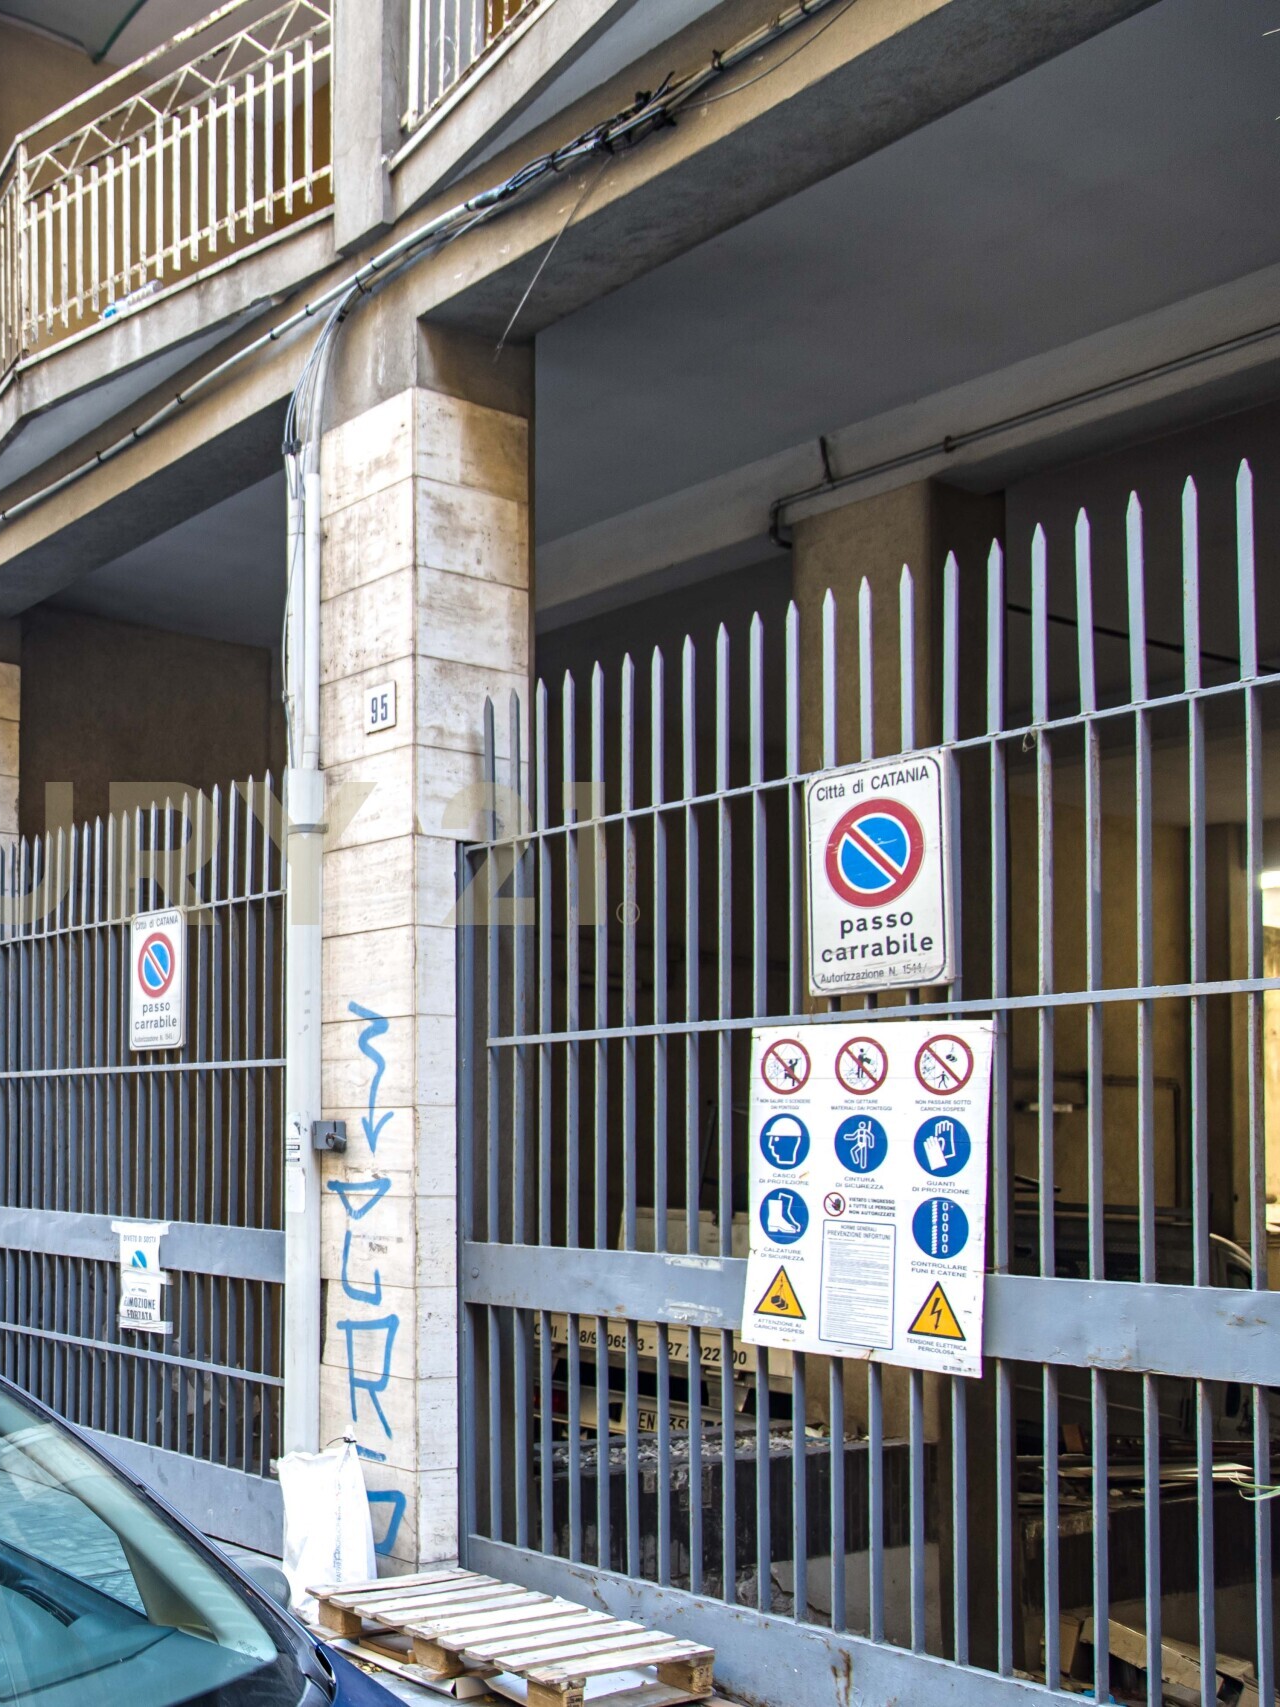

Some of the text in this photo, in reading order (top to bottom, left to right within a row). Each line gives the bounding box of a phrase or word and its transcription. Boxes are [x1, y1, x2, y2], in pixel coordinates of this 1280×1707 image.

[371, 693, 388, 724] 95
[816, 765, 929, 802] Città di CATANIA
[156, 915, 178, 927] CATANIA
[840, 911, 914, 939] passo
[821, 933, 934, 963] carrabile
[820, 969, 884, 984] Autorizzazione
[888, 966, 898, 977] N.
[142, 1001, 171, 1016] passo
[135, 1015, 177, 1030] carrabile
[921, 1187, 970, 1195] PROTEZIONE
[861, 1210, 895, 1218] AUTORIZZATE
[827, 1230, 861, 1238] PREVENZIONE
[763, 1247, 801, 1255] CALZATURE
[911, 1260, 967, 1271] CONTROLLARE
[937, 1270, 967, 1278] CATENE
[754, 1323, 778, 1331] CARICHI
[758, 1319, 794, 1327] ATTENZIONE
[906, 1337, 967, 1351] TENSIONE ELETTRICA
[918, 1346, 954, 1355] PERICOLOSA
